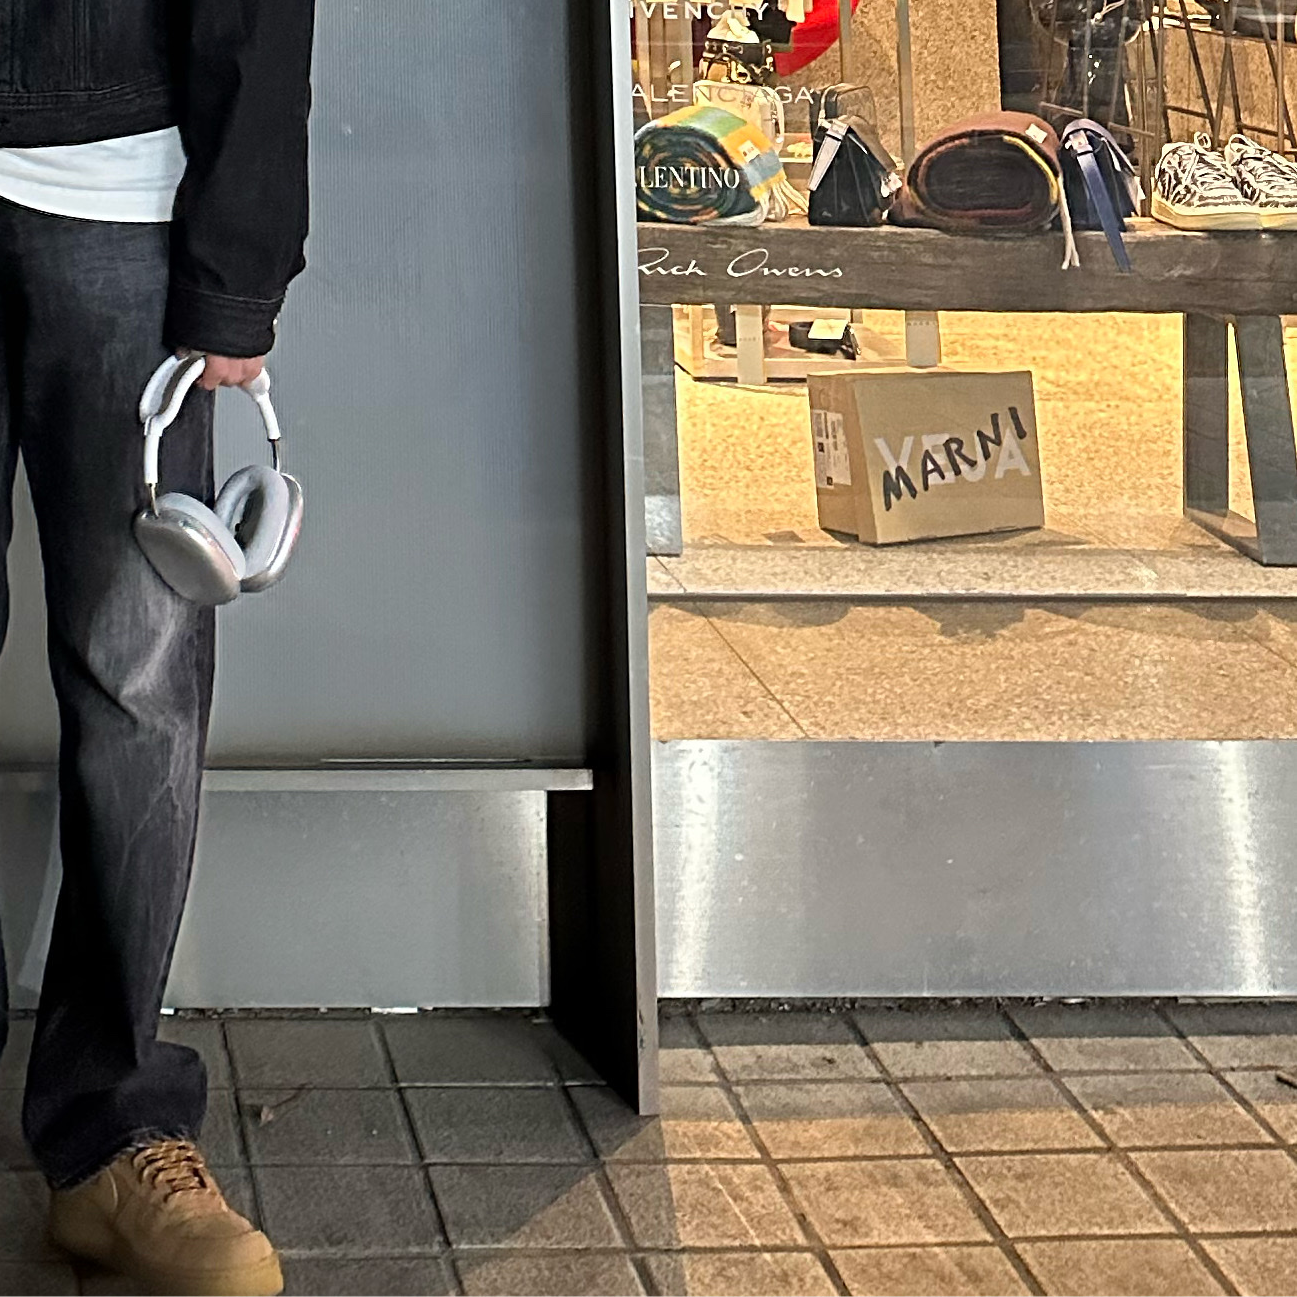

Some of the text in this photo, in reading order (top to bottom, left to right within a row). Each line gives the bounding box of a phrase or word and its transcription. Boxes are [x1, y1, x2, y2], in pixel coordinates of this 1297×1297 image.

[634, 165, 740, 189] LENTINO
[637, 247, 843, 278] Rick Owens
[882, 406, 1027, 512] MARNI
